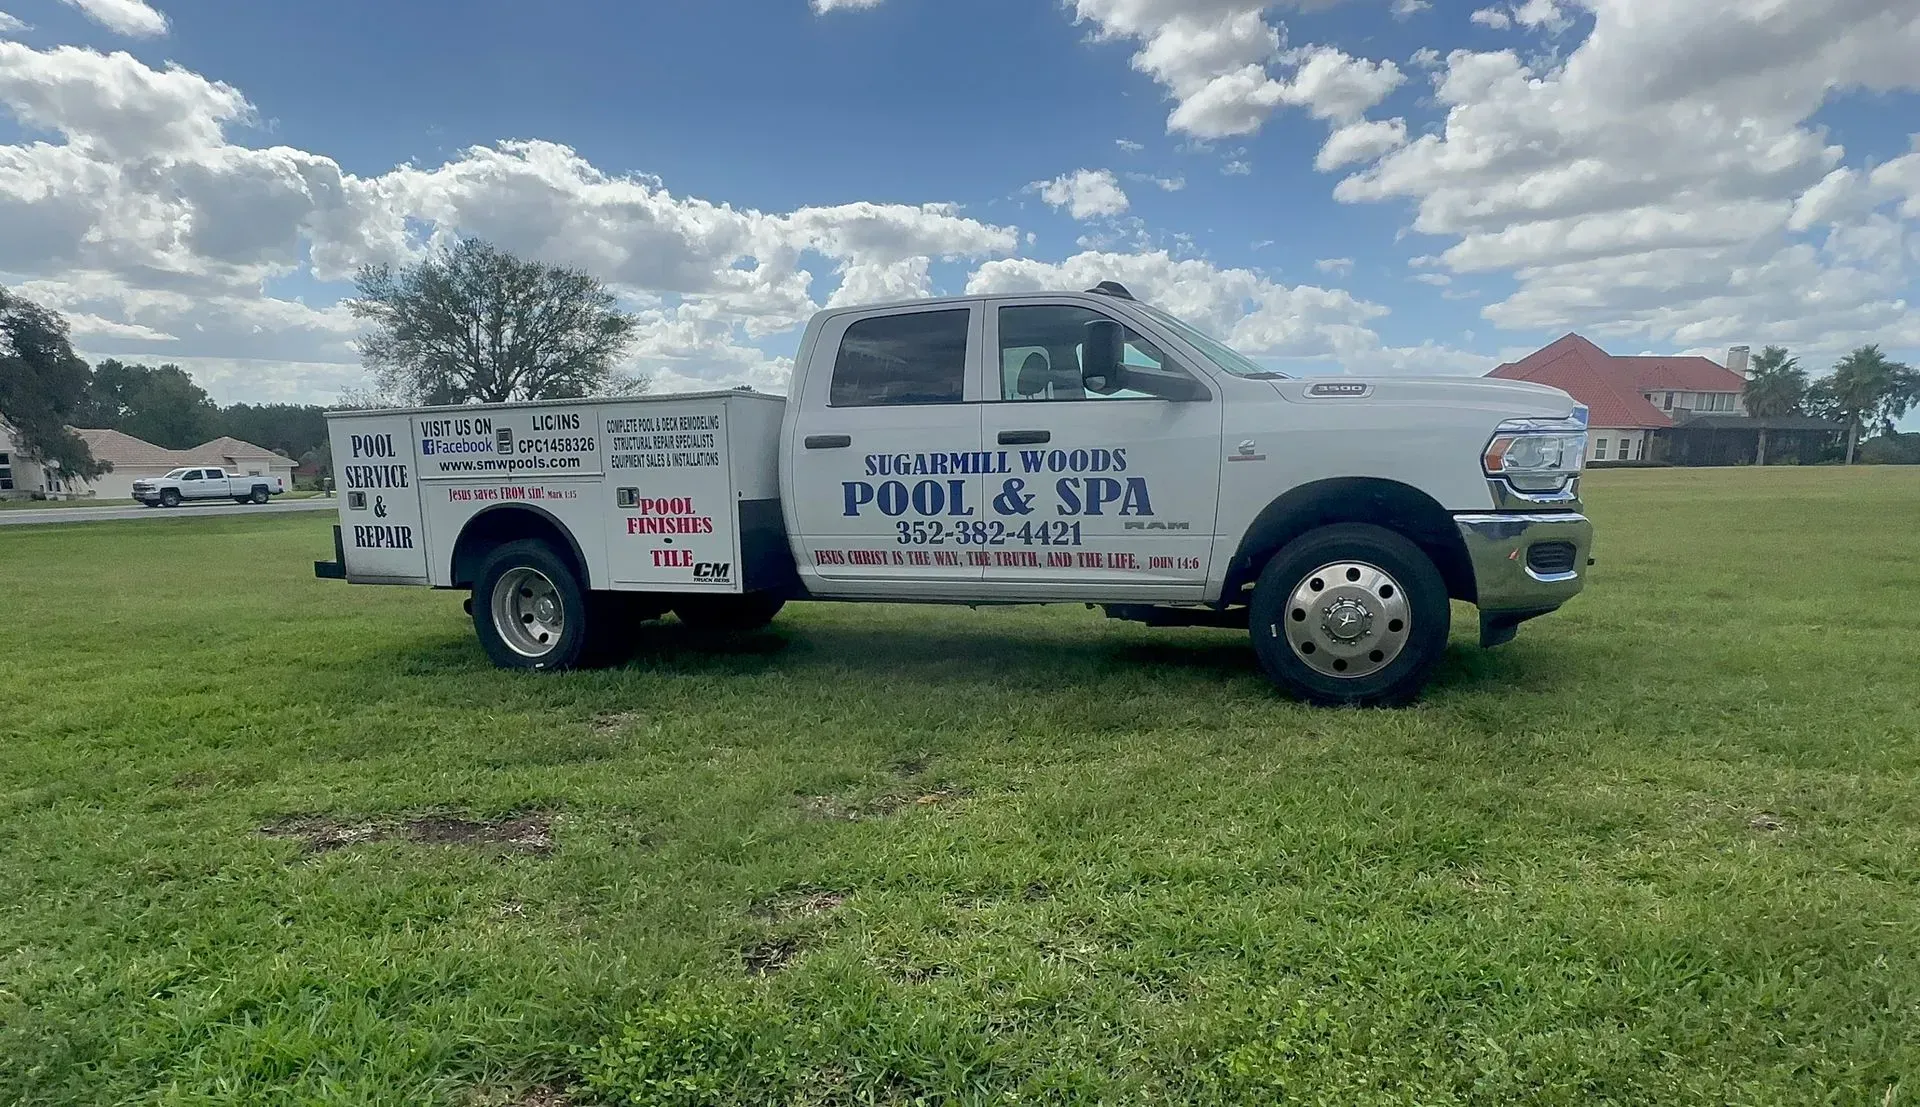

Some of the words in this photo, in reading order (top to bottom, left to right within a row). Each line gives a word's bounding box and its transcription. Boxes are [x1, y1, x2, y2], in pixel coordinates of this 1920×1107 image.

[421, 420, 451, 437] VISIT
[455, 419, 471, 436] US
[474, 418, 492, 435] ON
[532, 413, 580, 431] LIC/INS
[606, 418, 637, 433] COMPLETE
[638, 418, 654, 432] POOL
[656, 417, 660, 432] &
[662, 416, 678, 431] DECK
[680, 415, 719, 430] REMODELING
[350, 434, 396, 458] POOL
[436, 438, 492, 454] Facebook
[518, 437, 594, 453] CPC1458326
[614, 436, 652, 450] STRUCTURAL
[653, 435, 674, 450] REPAIR
[676, 434, 714, 448] SPECIALISTS
[439, 456, 580, 472] www.smwpools.com
[612, 454, 644, 468] EQUIPMENT
[646, 453, 665, 468] SALES
[666, 453, 671, 467] &
[672, 452, 719, 466] INSTALLATIONS
[864, 450, 1012, 476] SUGARMILL
[1020, 448, 1127, 474] WOODS
[346, 464, 408, 488] SERVICE
[449, 488, 471, 502] Jesus
[474, 489, 498, 500] saves
[500, 486, 525, 500] FROM
[528, 486, 545, 499] sin!
[548, 490, 562, 498] Mark
[841, 479, 974, 517] POOL
[992, 477, 1036, 516] &
[1056, 476, 1154, 516] SPA
[374, 495, 388, 518] &
[640, 497, 696, 516] POOL
[626, 516, 713, 534] FINISHES
[896, 520, 1082, 546] 352-382-4421
[1124, 522, 1190, 530] RAM
[354, 525, 414, 548] REPAIR
[650, 550, 694, 567] TILE
[814, 550, 845, 566] JESUS
[848, 550, 888, 565] CHRIST
[892, 550, 904, 566] IS
[906, 550, 931, 566] THE
[934, 551, 963, 567] WAY,
[966, 551, 992, 566] THE
[994, 551, 1042, 568] TRUTH,
[1047, 552, 1072, 568] AND
[1076, 552, 1104, 568] THE
[1107, 552, 1140, 570] LIFE.
[1148, 556, 1174, 570] JOHN
[1177, 556, 1200, 570] 14:6
[693, 562, 731, 578] CM
